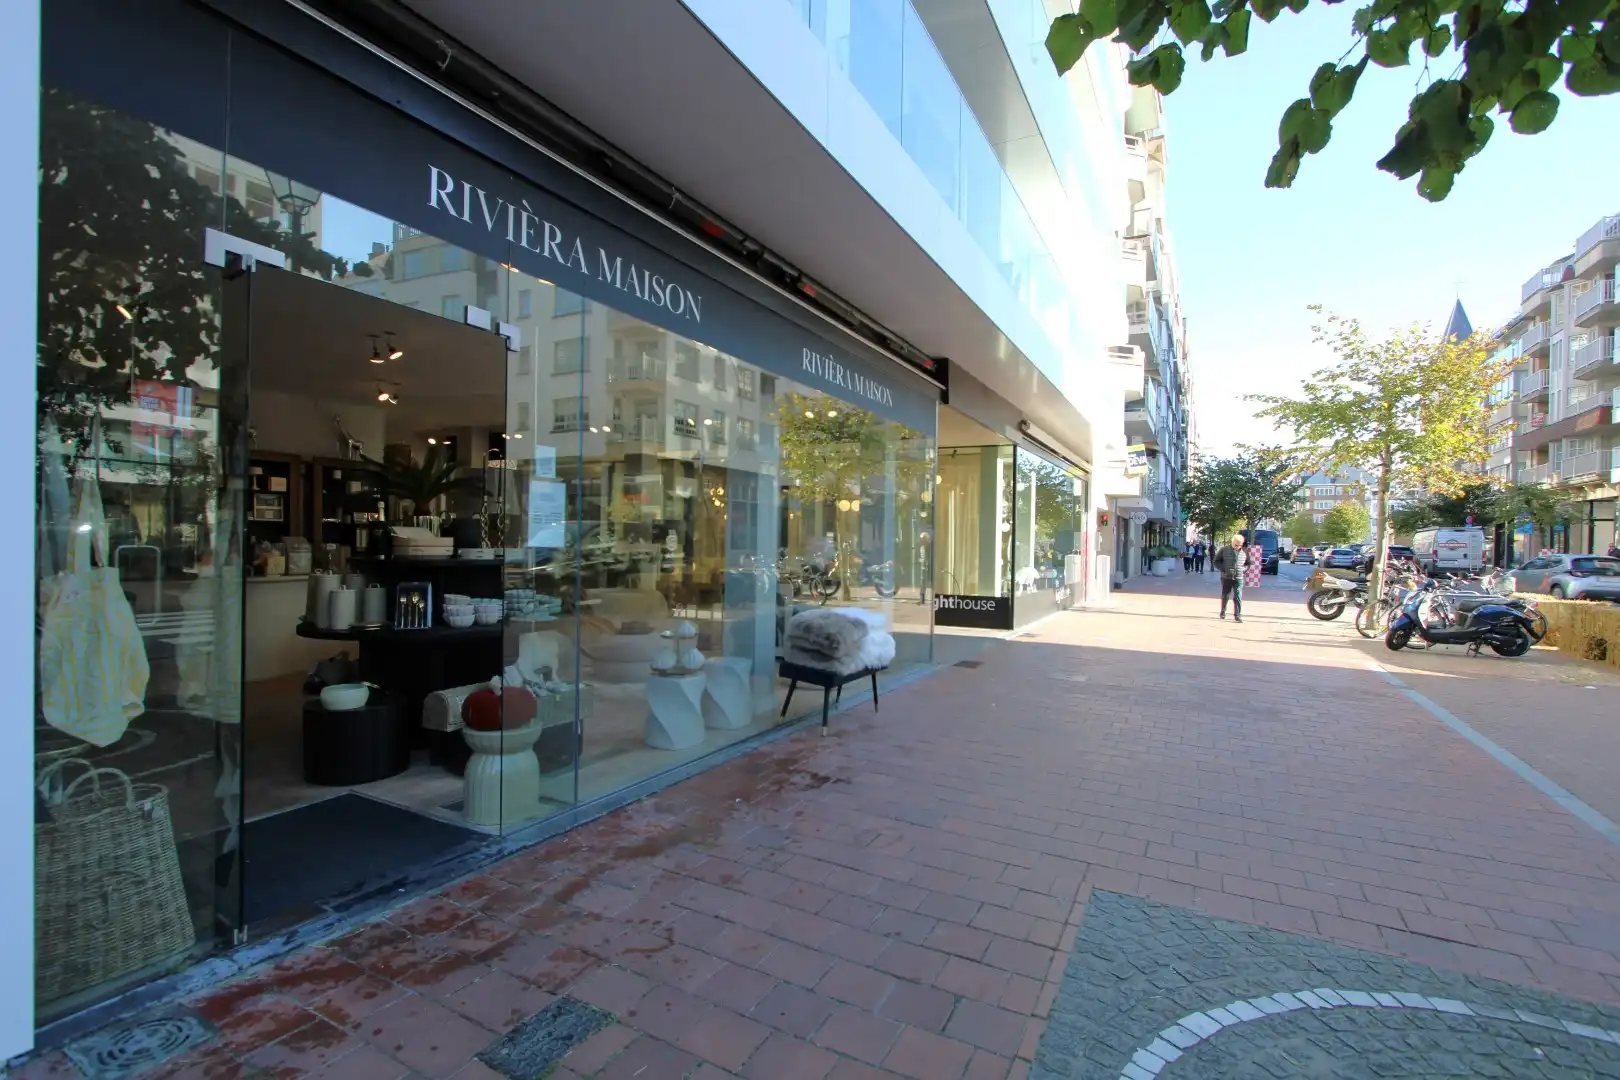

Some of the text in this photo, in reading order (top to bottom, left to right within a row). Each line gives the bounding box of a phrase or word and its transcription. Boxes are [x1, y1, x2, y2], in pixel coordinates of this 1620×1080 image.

[427, 164, 703, 324] RIVIÈRA MAISON
[802, 347, 893, 408] RIVIÈRA MAISON
